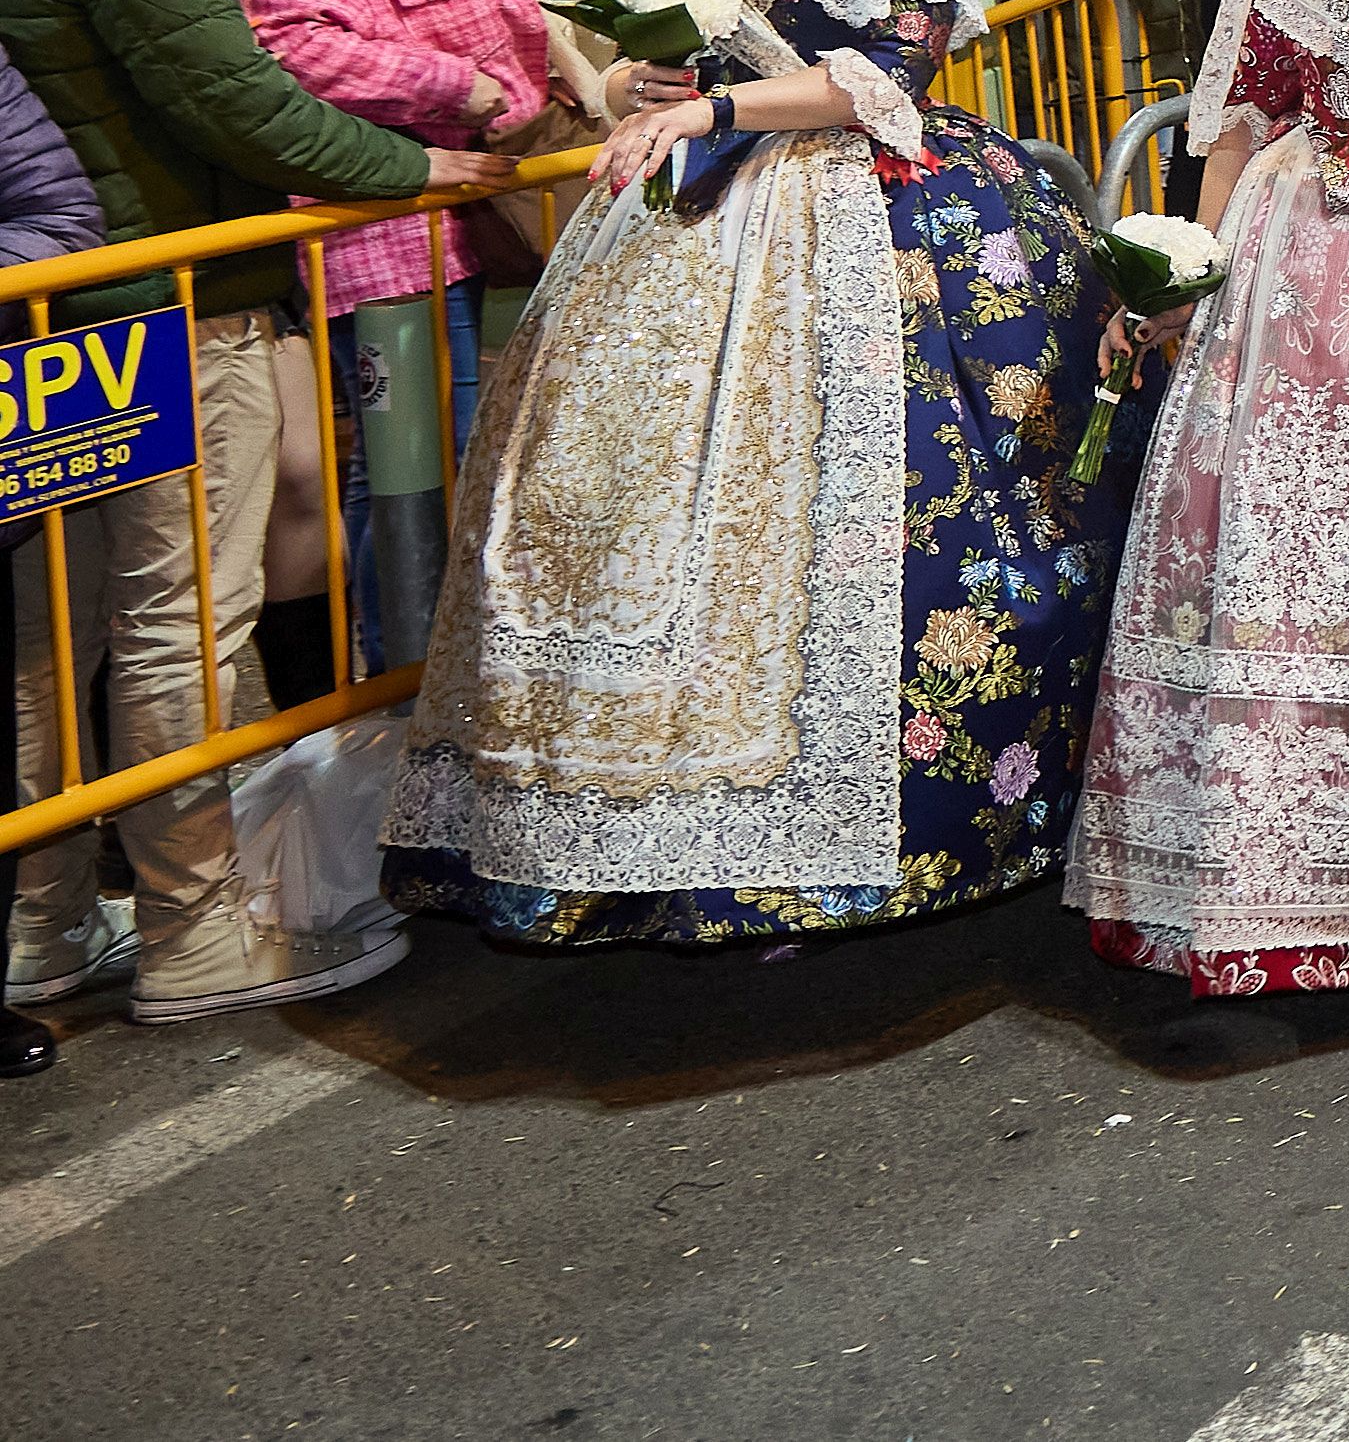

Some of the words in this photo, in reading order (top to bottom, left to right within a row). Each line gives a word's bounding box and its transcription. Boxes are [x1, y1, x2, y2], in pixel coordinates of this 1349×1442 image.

[23, 461, 65, 489] 154
[68, 452, 99, 478] 88
[102, 443, 131, 468] 30
